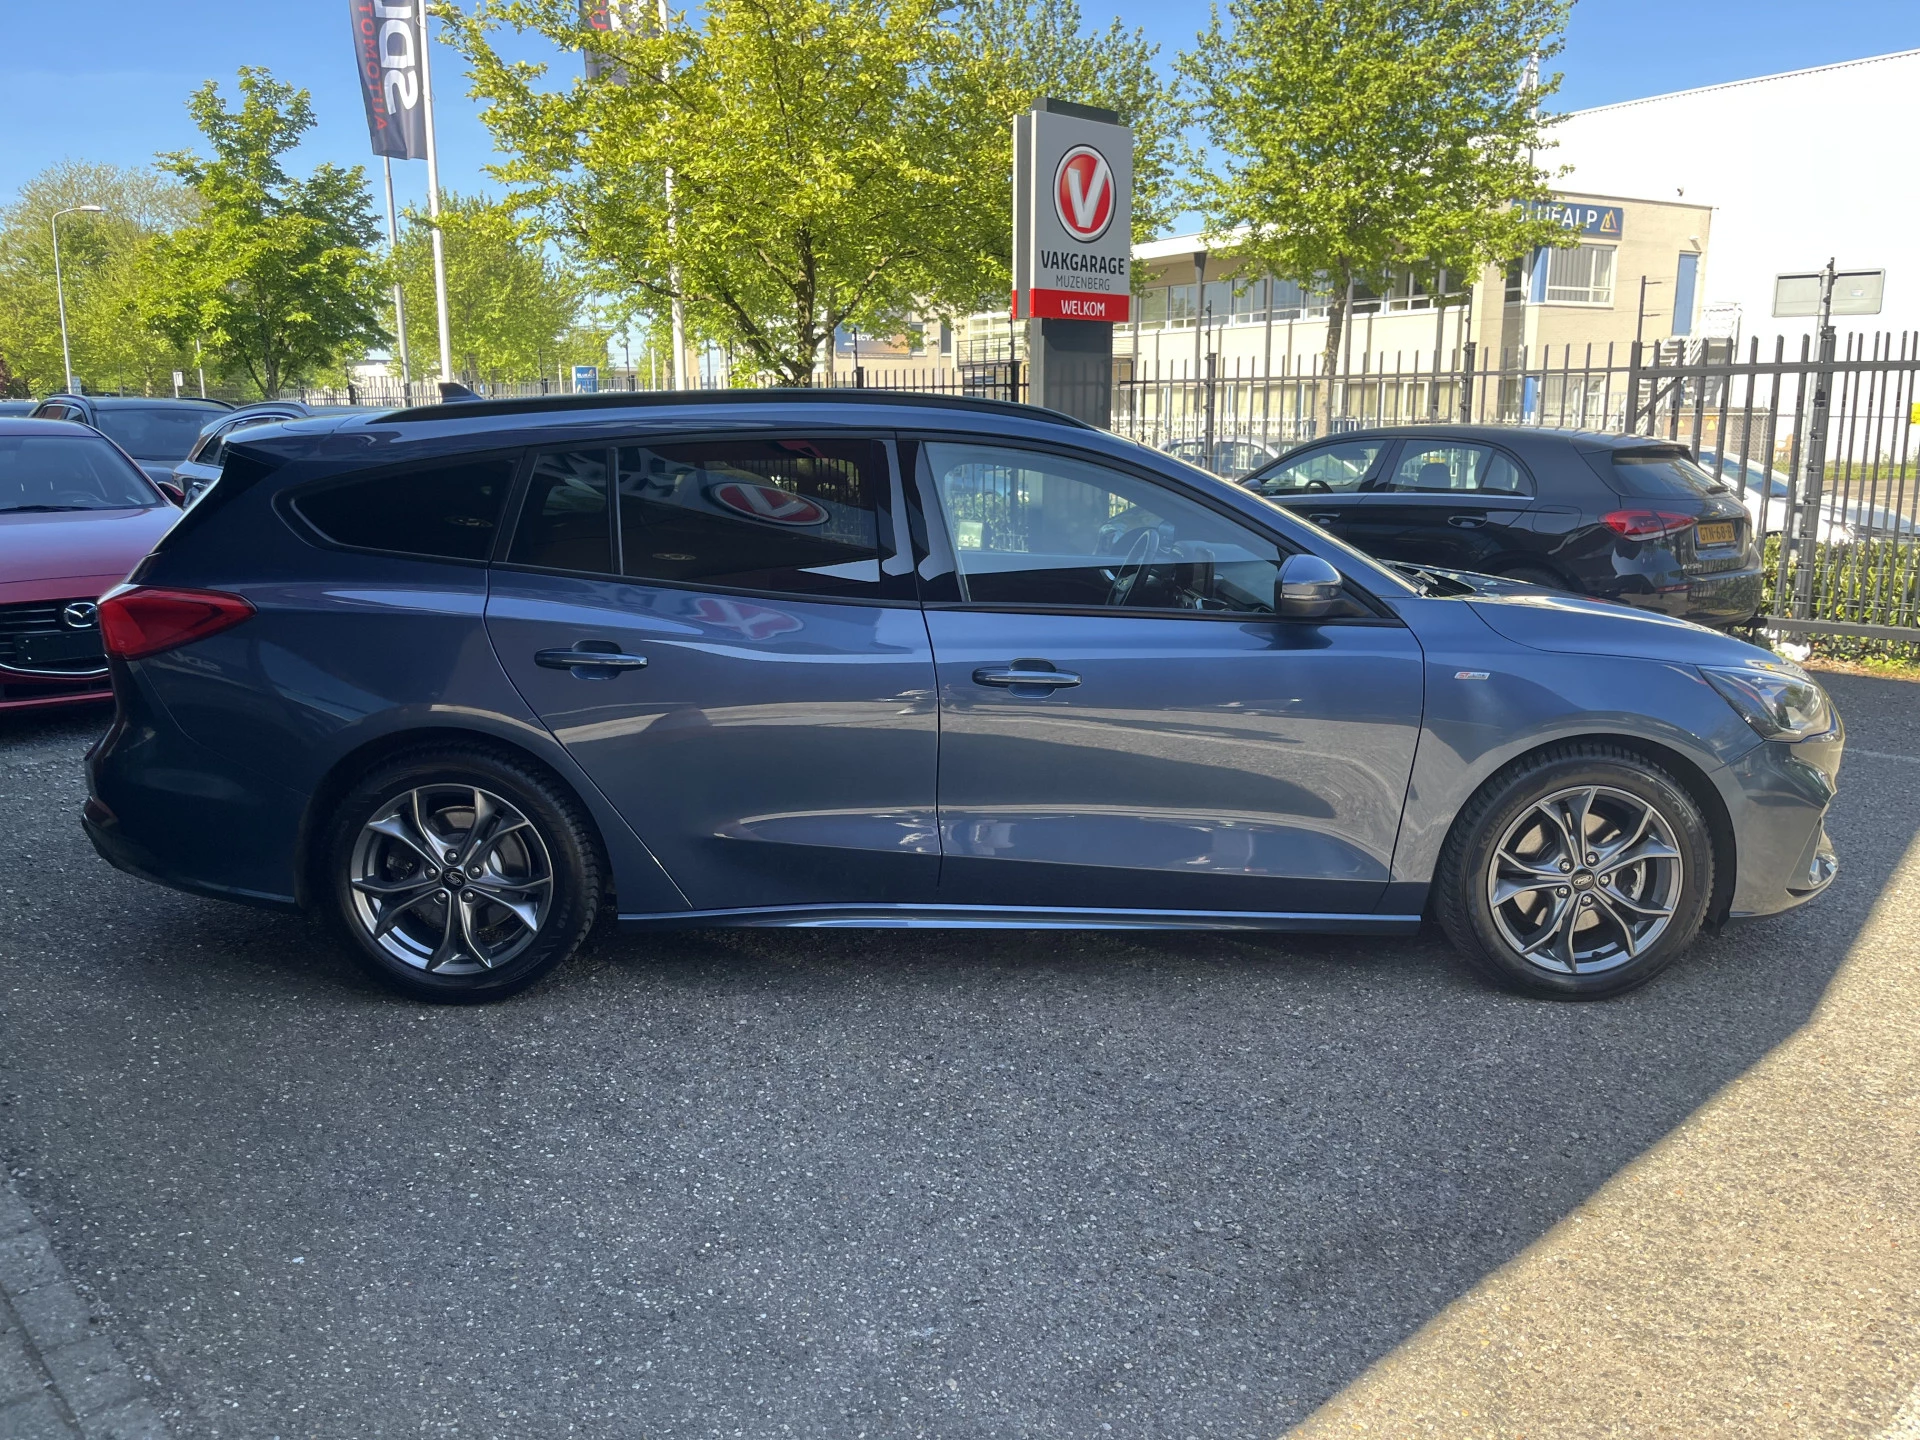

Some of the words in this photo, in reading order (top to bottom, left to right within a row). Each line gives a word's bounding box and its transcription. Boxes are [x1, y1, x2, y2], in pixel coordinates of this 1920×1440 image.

[1041, 250, 1125, 275] VAKGARAGE
[1055, 275, 1111, 291] MUZENBERG
[1060, 299, 1106, 317] WELKOM
